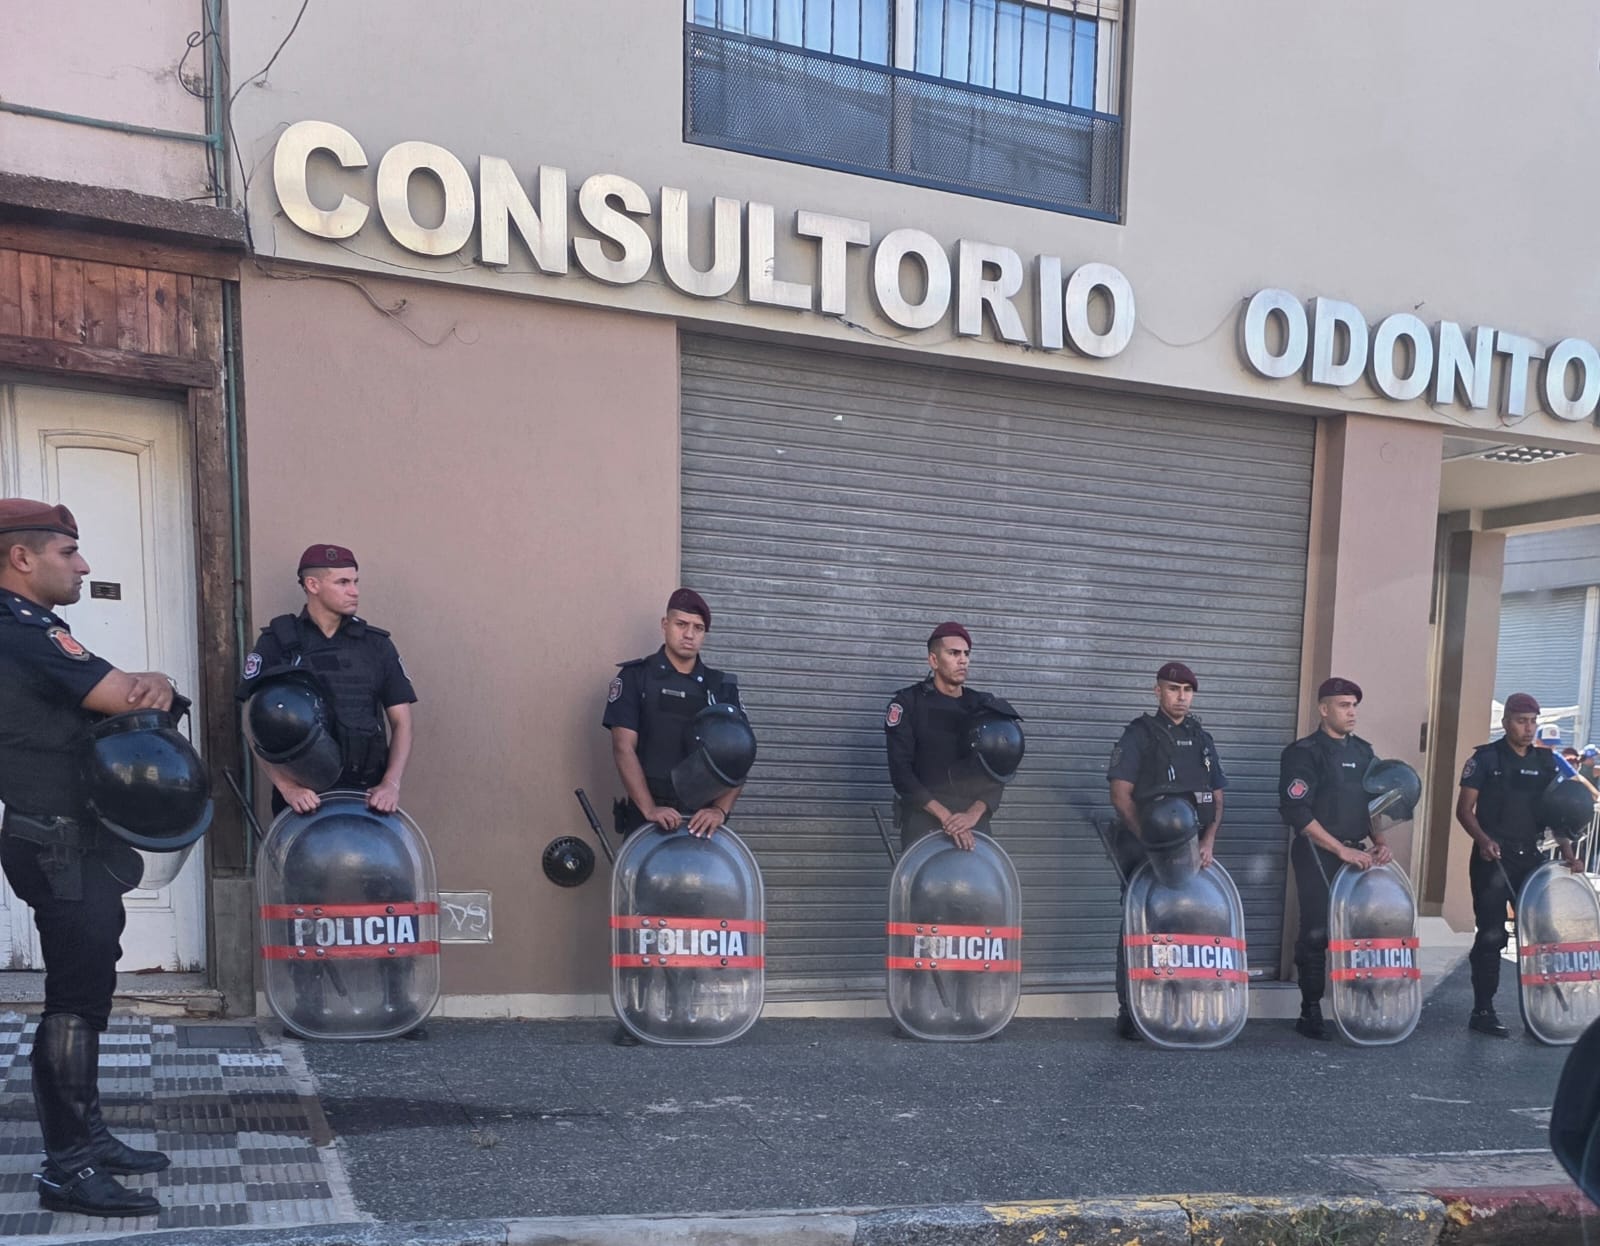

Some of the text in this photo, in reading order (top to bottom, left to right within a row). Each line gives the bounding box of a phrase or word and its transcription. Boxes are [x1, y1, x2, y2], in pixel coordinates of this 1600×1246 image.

[273, 119, 1600, 421] CONSULTORIO ODONTO
[294, 915, 416, 947] POLICIA
[638, 928, 744, 956] POLICIA
[913, 935, 1004, 961] POLICIA
[1151, 944, 1233, 970] POLICIA
